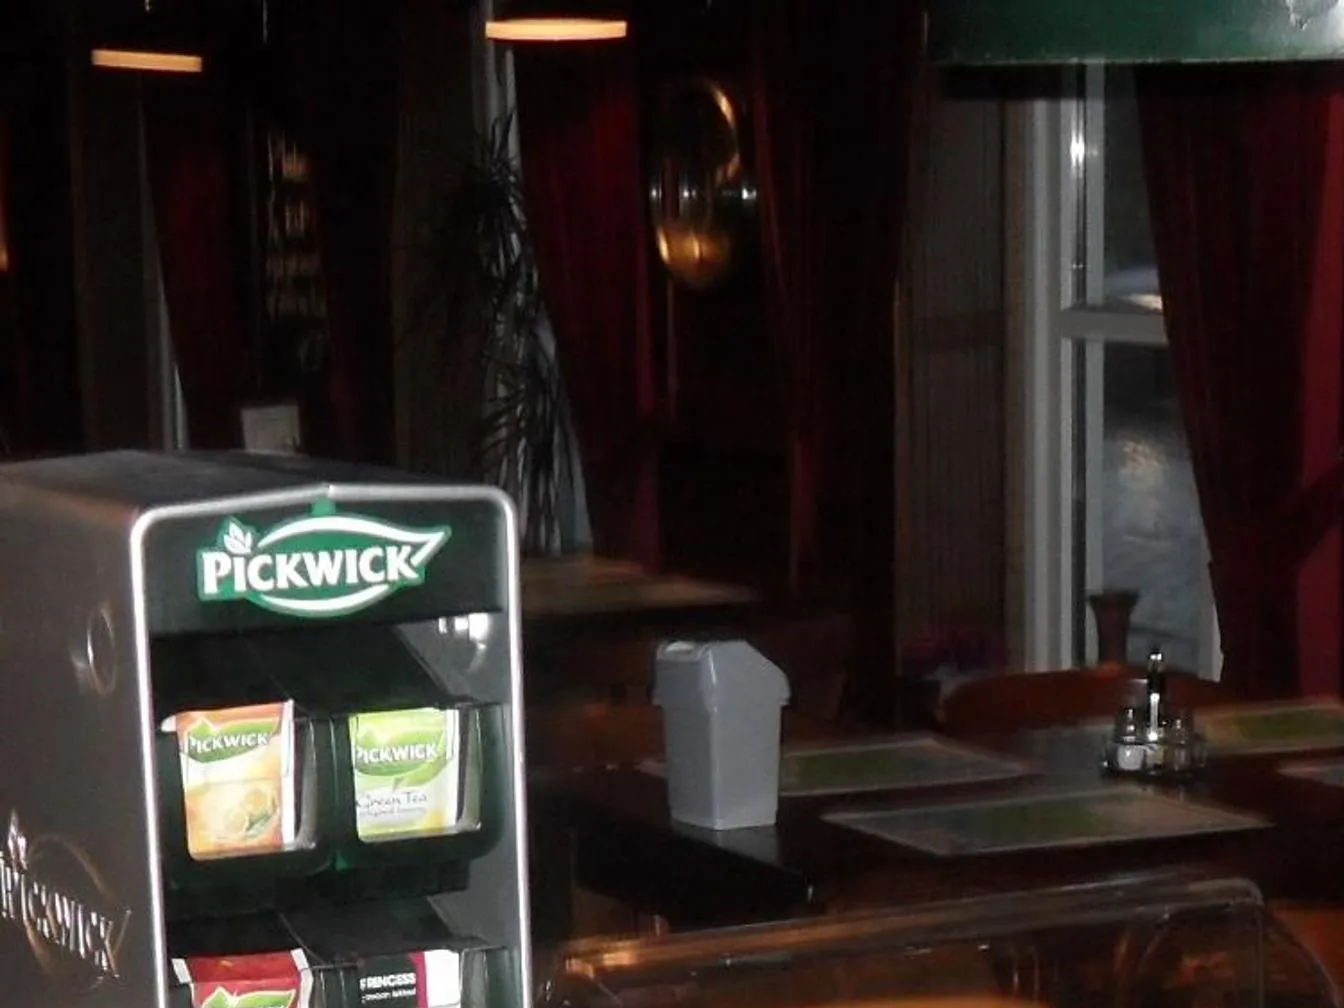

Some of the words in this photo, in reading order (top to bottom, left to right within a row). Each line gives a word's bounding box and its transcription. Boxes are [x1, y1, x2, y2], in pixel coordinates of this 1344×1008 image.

[201, 544, 420, 595] PICKWICK
[185, 732, 269, 754] PICKWICK
[355, 742, 438, 765] PICKWICK
